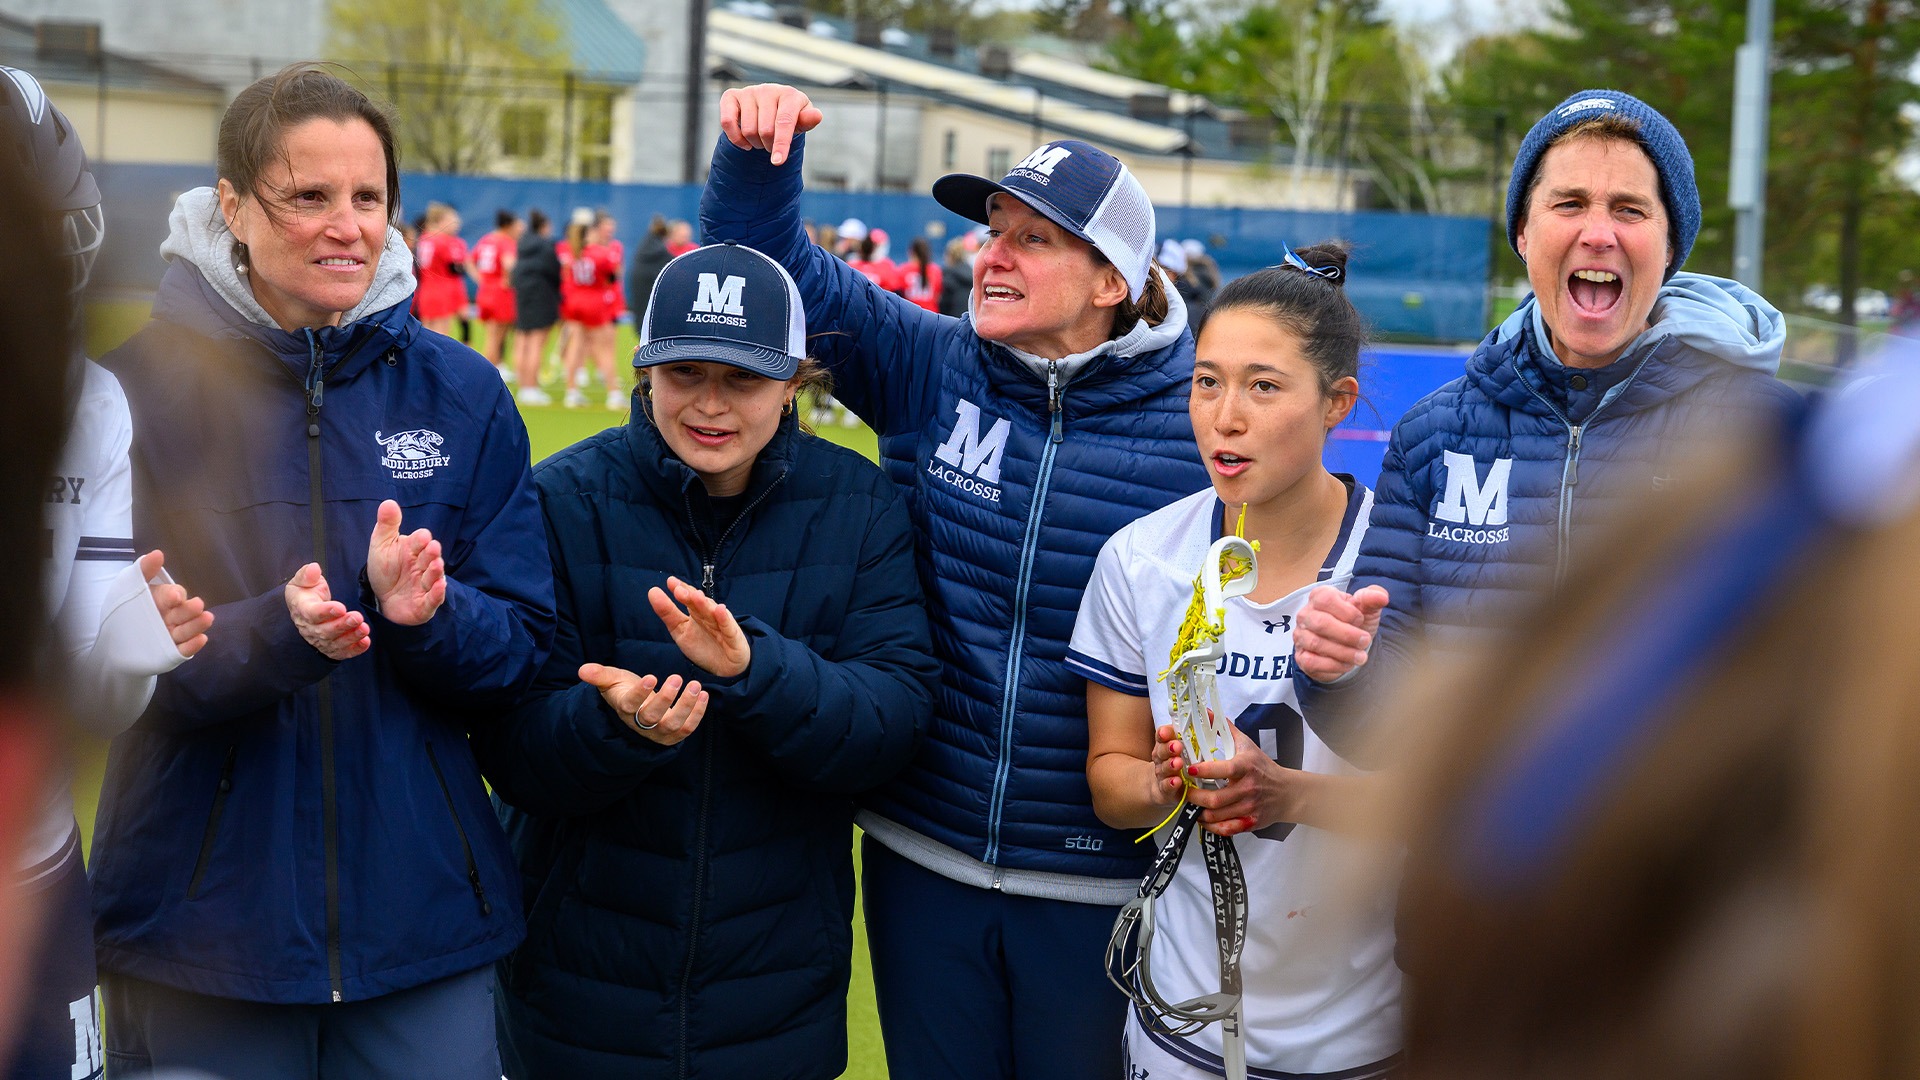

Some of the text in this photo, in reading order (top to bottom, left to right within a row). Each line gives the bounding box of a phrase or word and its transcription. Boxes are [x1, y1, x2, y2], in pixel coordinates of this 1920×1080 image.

[1014, 144, 1072, 176] M
[692, 272, 746, 316] M
[686, 313, 747, 328] LACROSSE
[381, 454, 450, 470] MIDDLEBURY
[934, 398, 1011, 484] M
[392, 469, 433, 479] LACROSSE
[927, 459, 1001, 502] LACROSSE
[1435, 449, 1512, 525] M
[1428, 522, 1510, 544] LACROSSE
[1065, 836, 1103, 851] stio
[1155, 825, 1184, 869] GAIT
[1205, 831, 1219, 874] GAIT
[1213, 882, 1226, 928] GAIT
